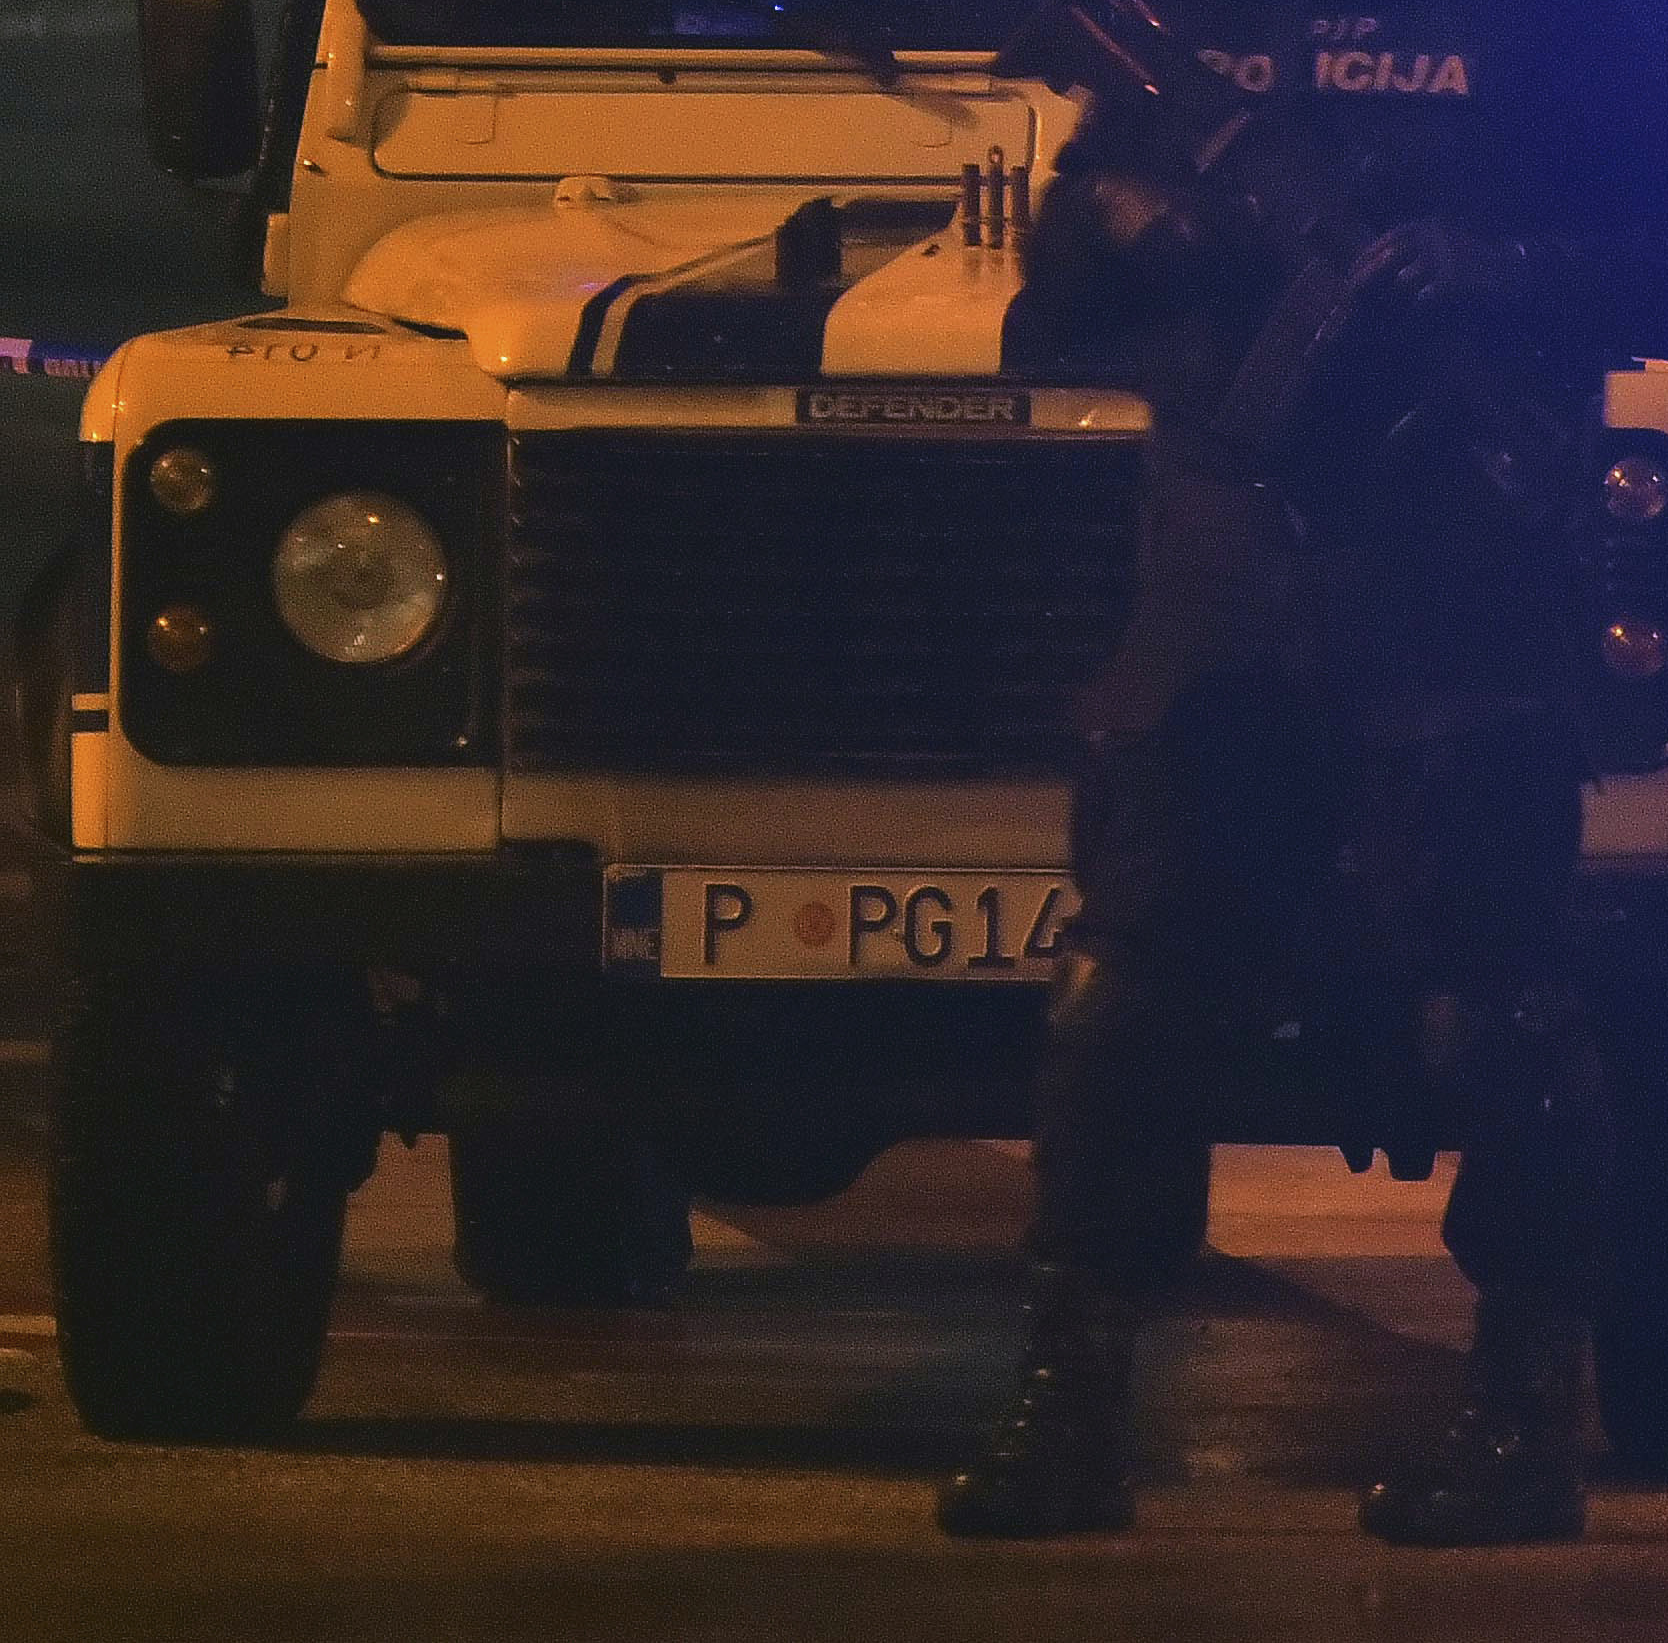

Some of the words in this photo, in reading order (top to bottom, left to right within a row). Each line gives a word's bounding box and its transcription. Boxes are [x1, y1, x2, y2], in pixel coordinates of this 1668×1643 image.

[1197, 48, 1469, 95] POICIJA
[808, 393, 1015, 421] DEFENDER
[703, 882, 753, 965] P
